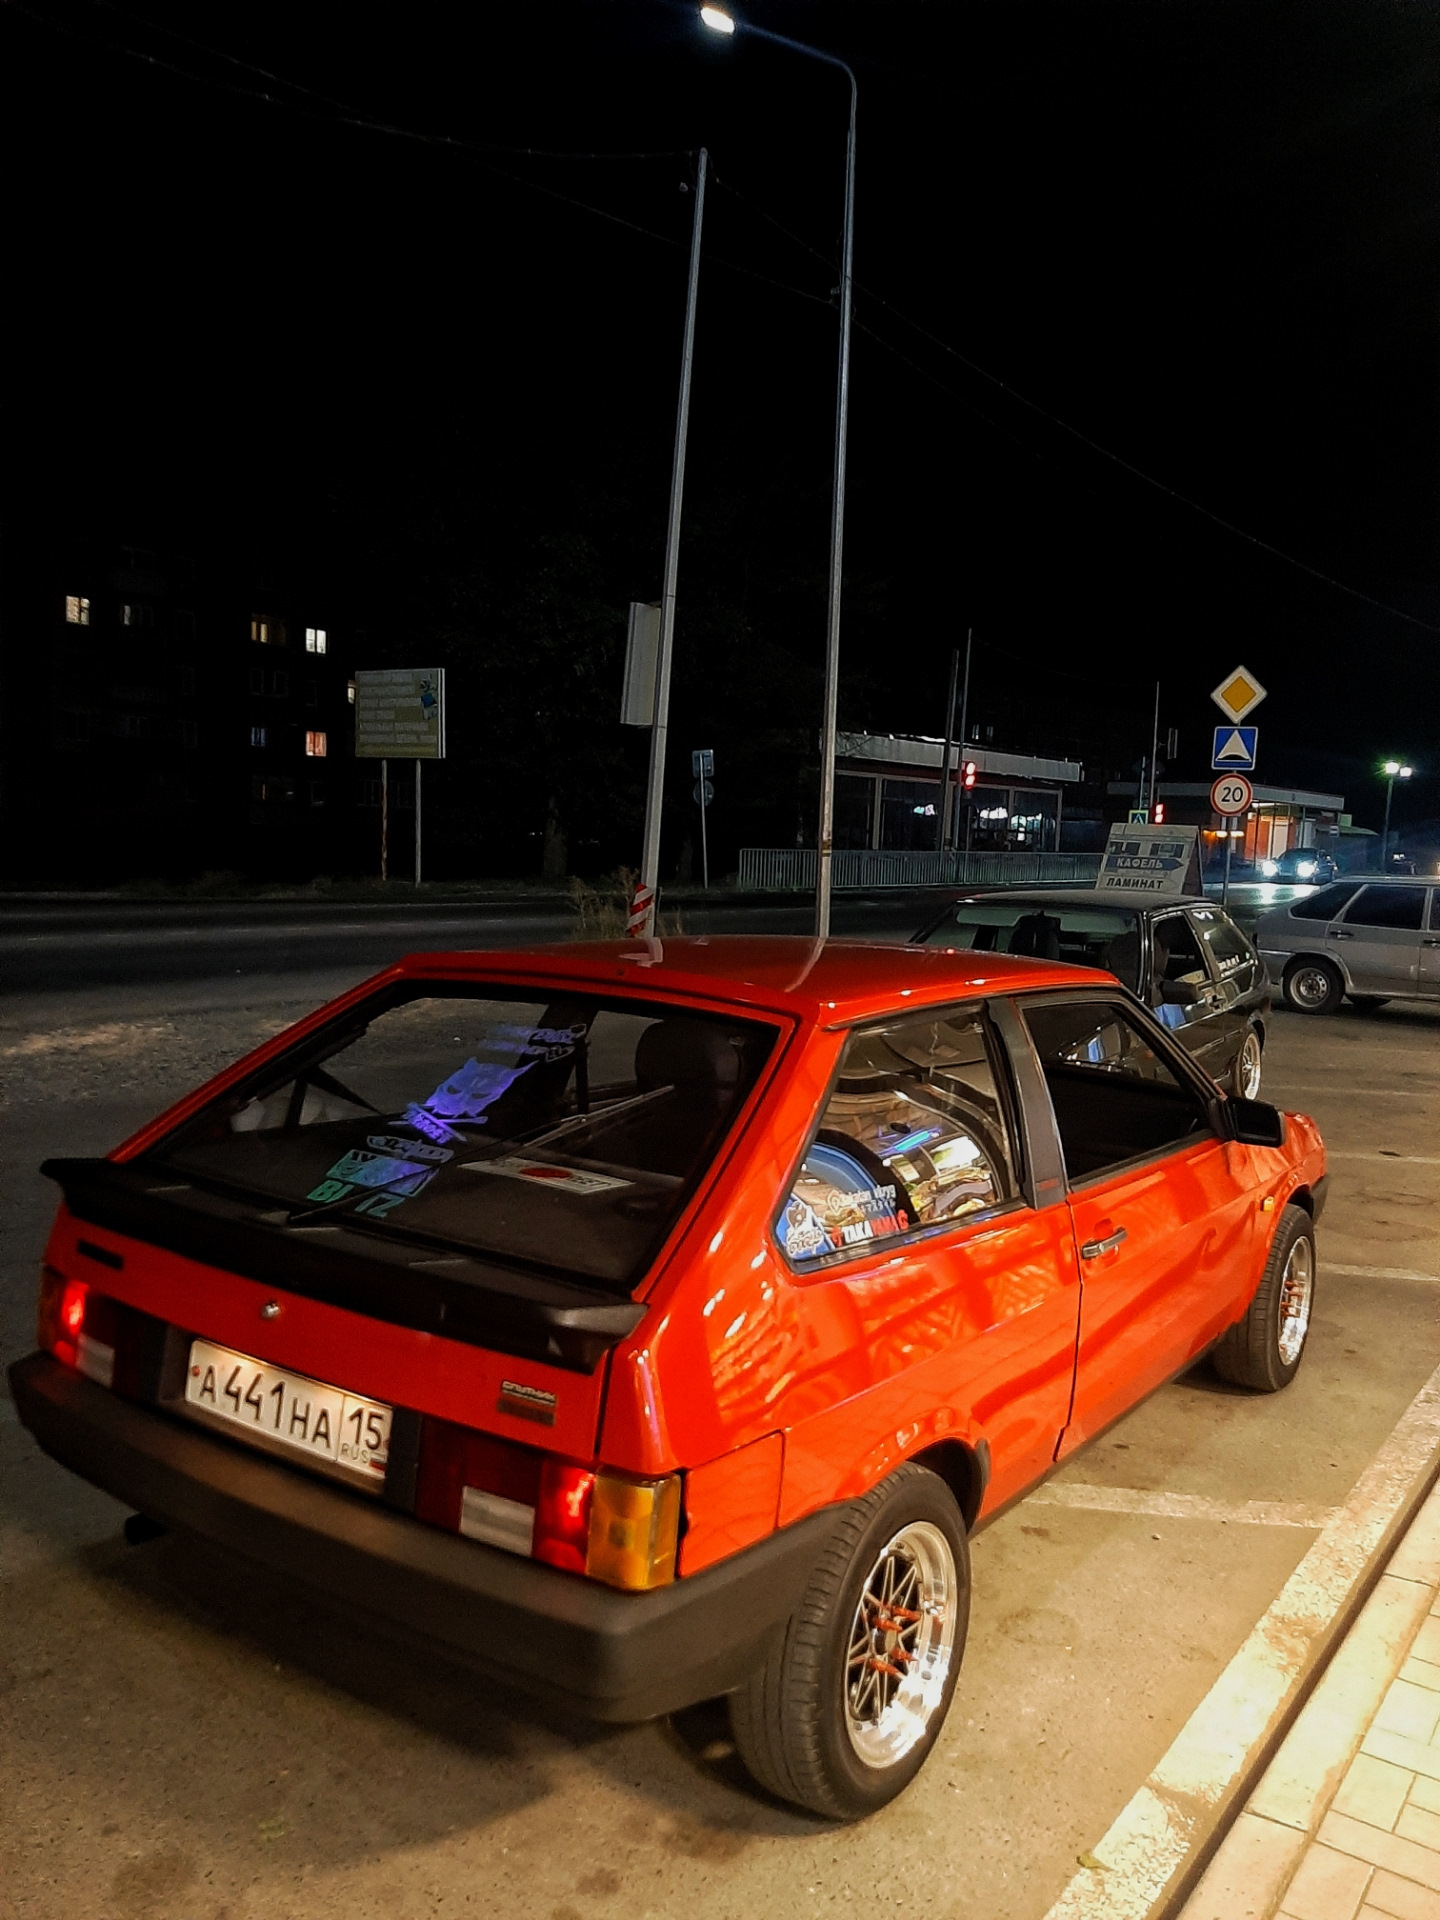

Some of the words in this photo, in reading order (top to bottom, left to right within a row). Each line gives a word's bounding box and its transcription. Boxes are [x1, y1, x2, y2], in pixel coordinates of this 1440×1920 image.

[1221, 786, 1243, 803] 20
[1116, 857, 1163, 869] КАФЕЛЬ
[1106, 877, 1164, 889] ЛАМИНАТ
[200, 1365, 332, 1449] А441НА
[348, 1406, 385, 1451] 15
[340, 1442, 370, 1463] RUS
